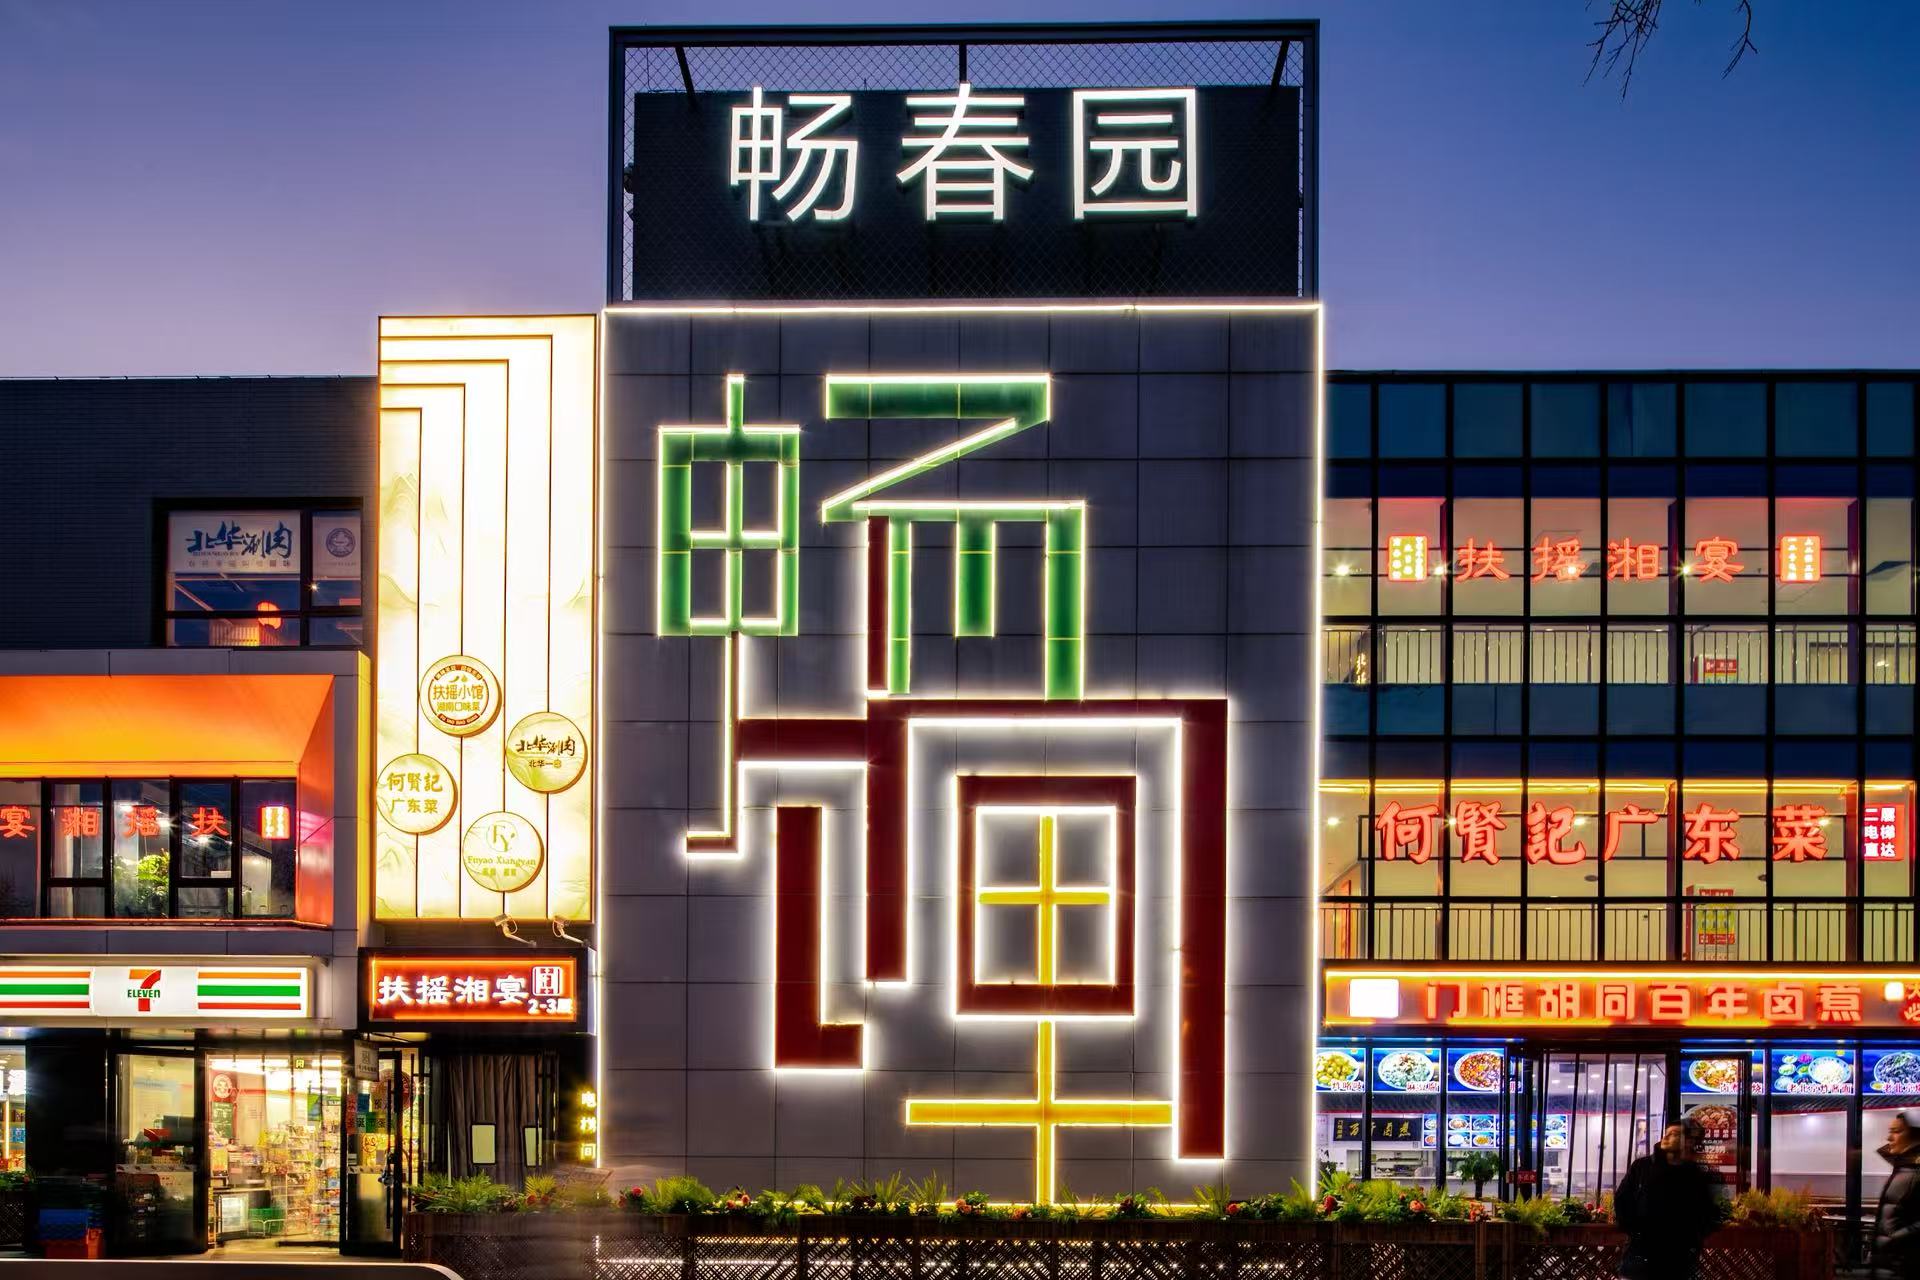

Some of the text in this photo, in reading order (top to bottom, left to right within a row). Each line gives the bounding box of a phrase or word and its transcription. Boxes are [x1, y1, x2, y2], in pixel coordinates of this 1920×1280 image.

[728, 82, 1197, 222] 畅春园
[185, 520, 293, 559] 北华涮肉
[1454, 535, 1745, 583] 扶摇湘宴
[433, 684, 484, 700] 扶摇小馆
[515, 734, 576, 756] 北华涮肉
[390, 798, 438, 816] 广东菜
[378, 975, 529, 1005] 扶摇湘宴
[1427, 981, 1862, 1022] 门框胡同百年卤煮
